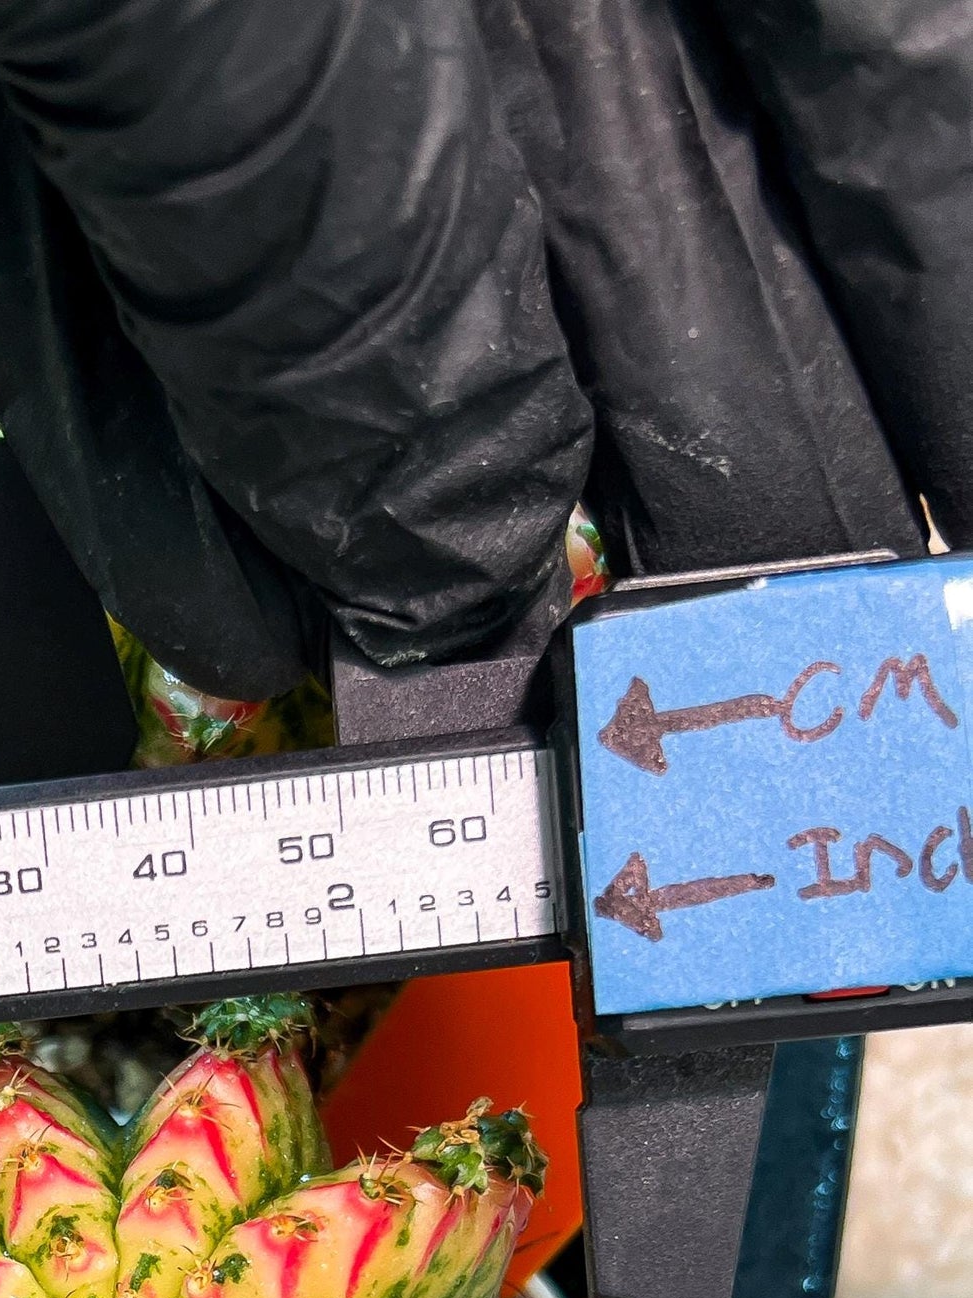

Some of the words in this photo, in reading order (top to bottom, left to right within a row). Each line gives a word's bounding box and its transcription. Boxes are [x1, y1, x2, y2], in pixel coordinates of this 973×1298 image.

[780, 653, 959, 743] CM
[133, 851, 186, 880] 40
[279, 834, 334, 864] 50
[429, 816, 486, 846] 60
[43, 936, 61, 954] 2
[81, 932, 98, 949] 3
[118, 928, 133, 945] 4
[154, 923, 170, 942] 5
[191, 919, 209, 937] 6
[233, 915, 247, 932] 7
[266, 911, 284, 929] 8
[304, 907, 322, 925] 9
[327, 883, 355, 911] 2
[419, 894, 436, 912] 2
[458, 889, 475, 906] 3
[496, 885, 512, 903] 4
[533, 879, 553, 900] 5
